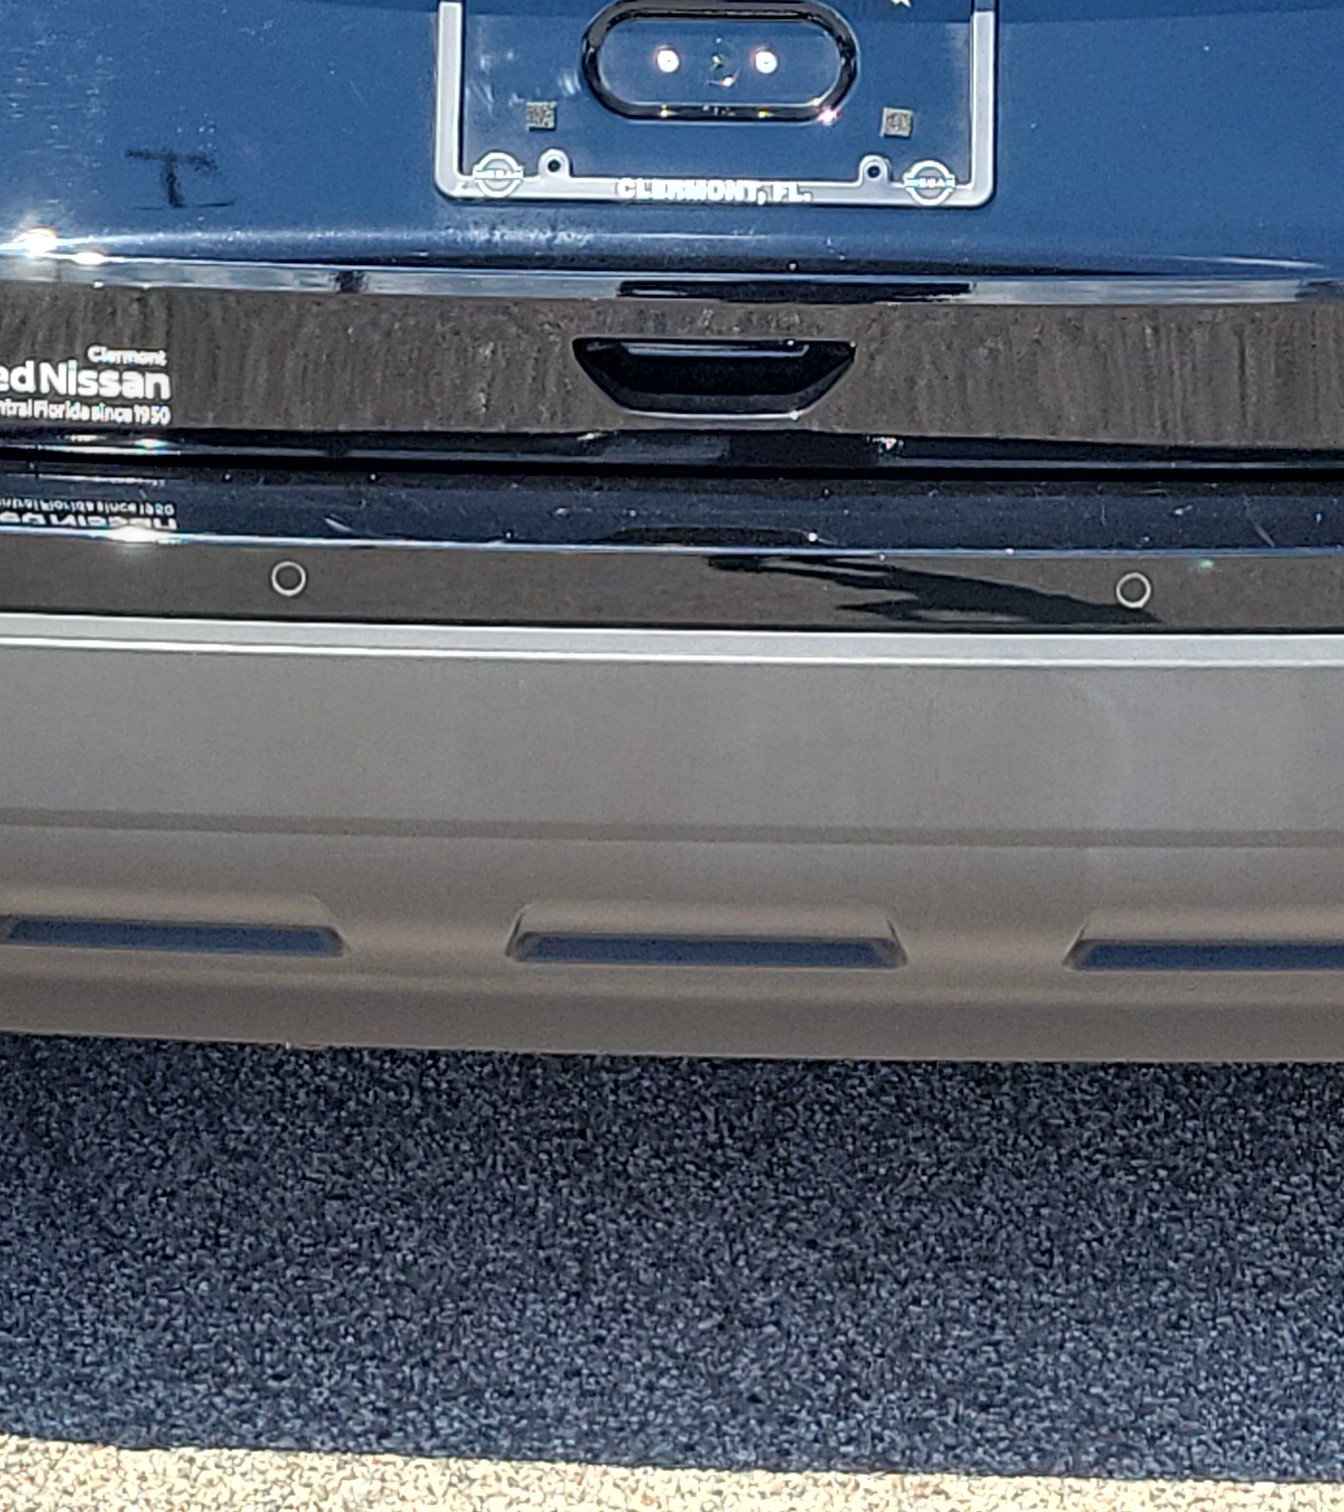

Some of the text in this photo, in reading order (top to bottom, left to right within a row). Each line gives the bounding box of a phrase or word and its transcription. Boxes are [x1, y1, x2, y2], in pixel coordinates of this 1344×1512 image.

[86, 344, 168, 367] Clermont
[39, 359, 172, 400] Nissan
[133, 404, 172, 425] 1950
